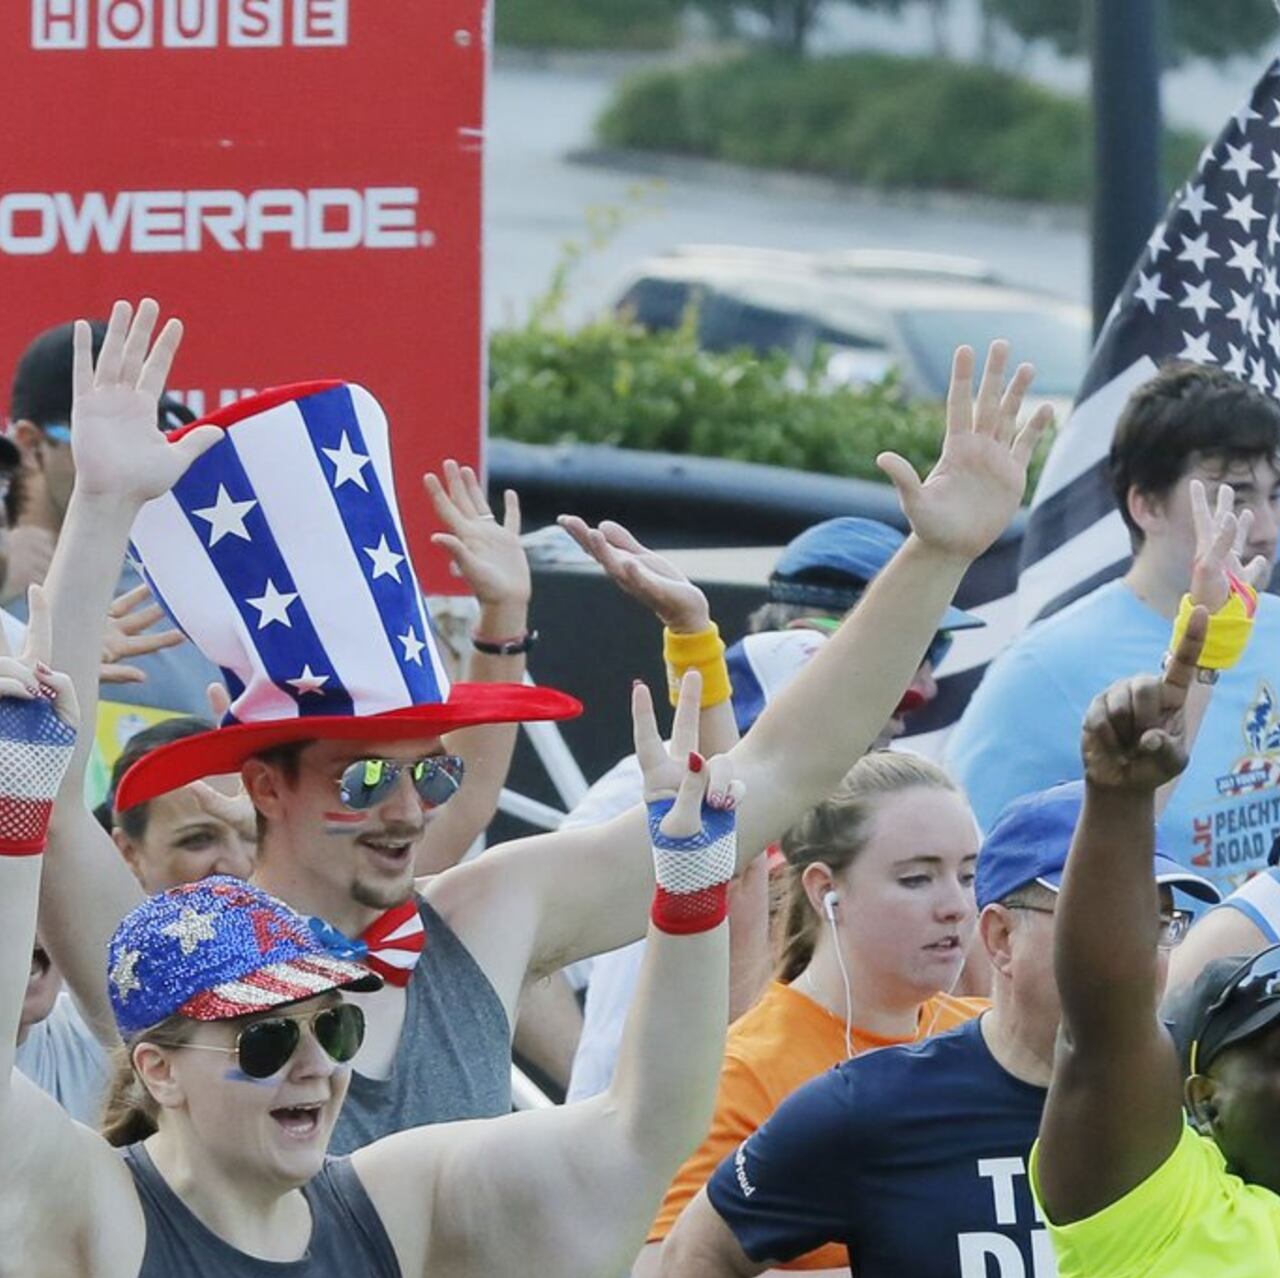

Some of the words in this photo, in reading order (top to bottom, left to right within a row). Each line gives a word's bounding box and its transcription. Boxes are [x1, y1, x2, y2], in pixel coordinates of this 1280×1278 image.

[45, 0, 334, 41] HOUSE
[1216, 832, 1264, 868] ROAD
[977, 1156, 1050, 1225] T
